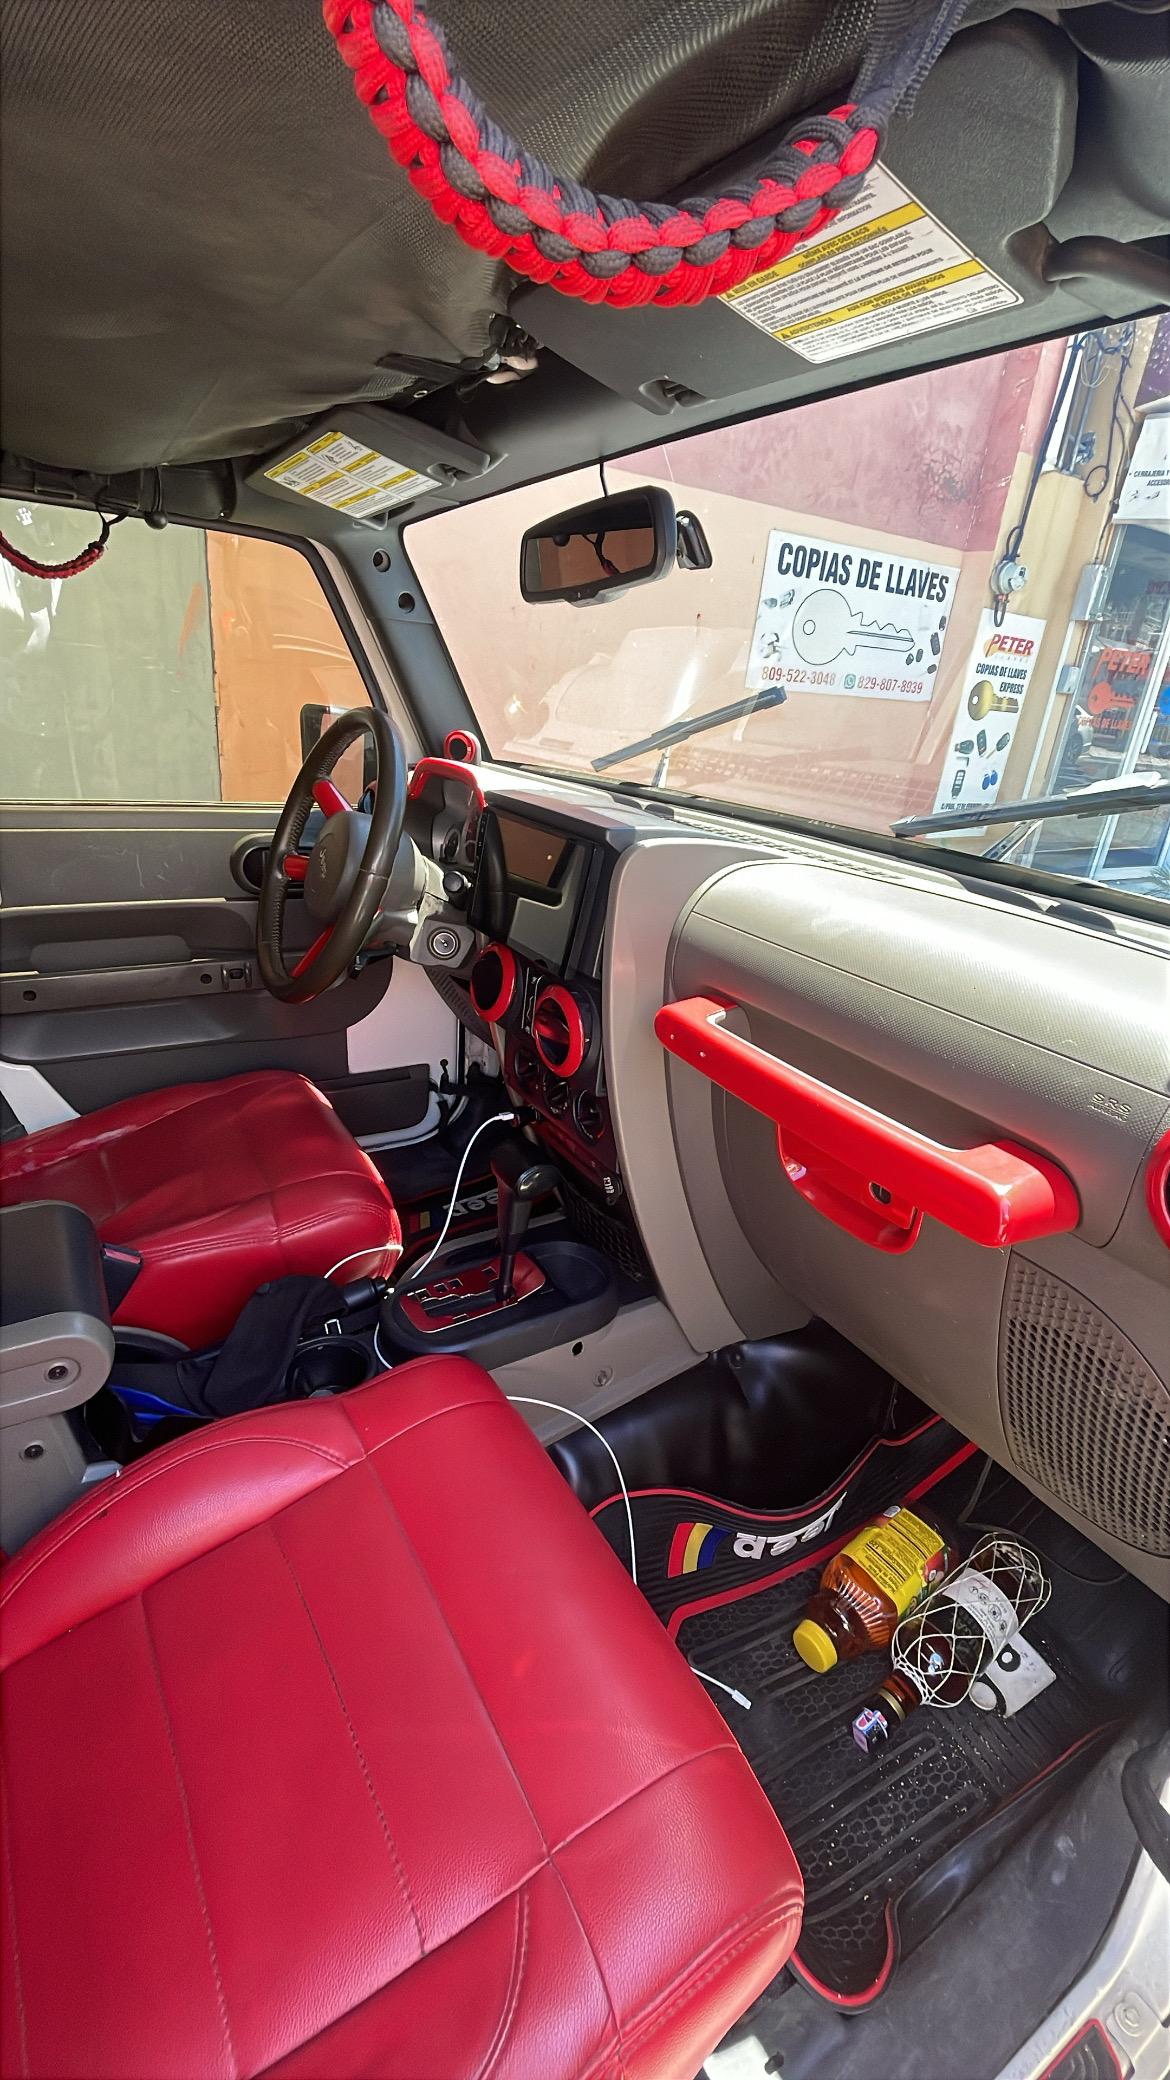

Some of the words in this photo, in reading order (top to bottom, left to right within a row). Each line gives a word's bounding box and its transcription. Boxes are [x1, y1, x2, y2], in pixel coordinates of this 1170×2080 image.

[819, 240, 840, 252] AVEC
[836, 234, 853, 244] DES
[848, 226, 871, 238] SACS
[787, 316, 835, 335] ADVERTENCIA
[777, 542, 853, 586] COPIAS
[856, 557, 882, 590] DE
[885, 564, 950, 602] LLAVES
[985, 634, 1034, 658] PETER
[761, 666, 836, 686] 809-522-3048
[858, 676, 923, 694] 829-807-8939
[976, 662, 1000, 676] COPIAS
[999, 666, 1008, 677] DE
[1008, 668, 1027, 680] LLAVES
[1000, 682, 1024, 694] EXPRESS
[1092, 1091, 1132, 1114] SRS
[443, 1188, 499, 1217] eep
[733, 1491, 848, 1560] Jeep
